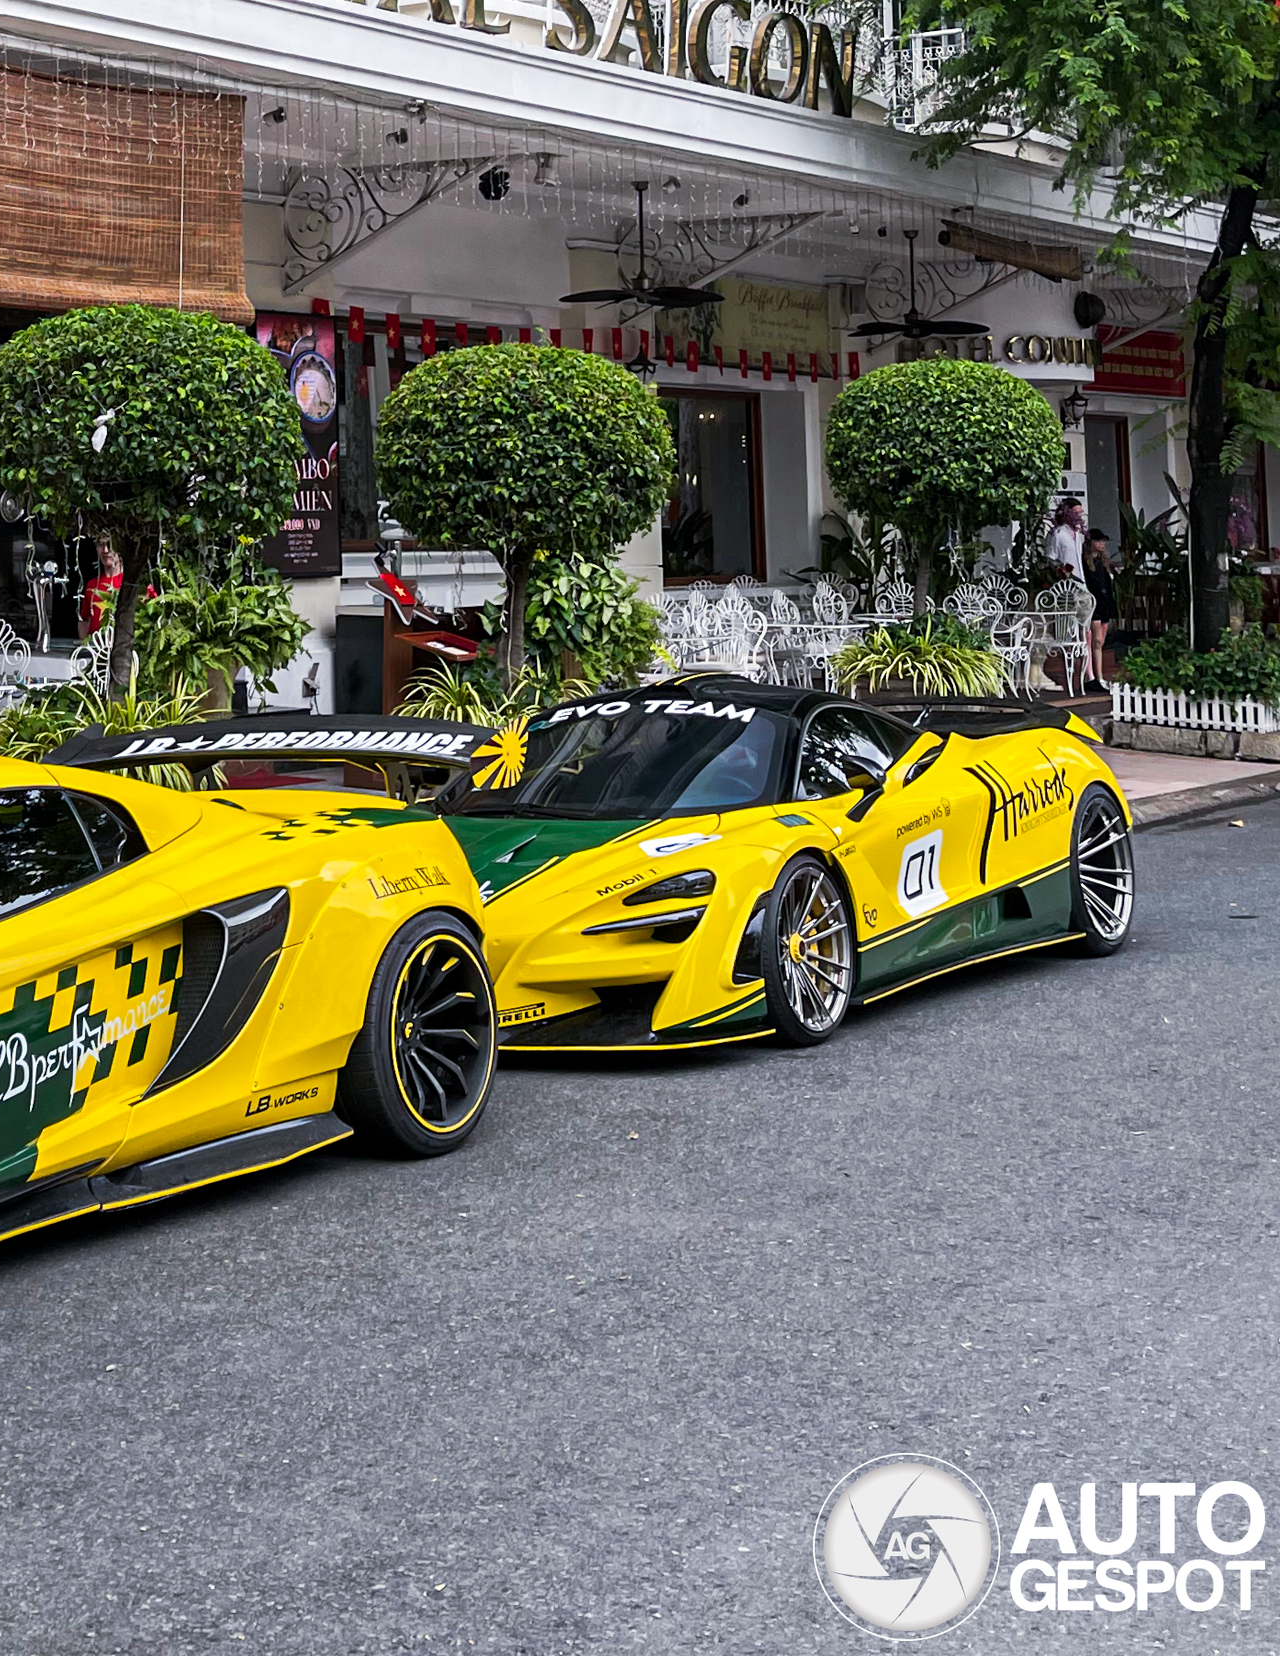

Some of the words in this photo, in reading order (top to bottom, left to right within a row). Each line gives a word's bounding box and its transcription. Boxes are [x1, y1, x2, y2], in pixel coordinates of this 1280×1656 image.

[543, 0, 858, 118] SAIGON
[549, 701, 631, 723] EVO
[644, 700, 756, 723] TEAM
[215, 731, 474, 756] PERFORMANCE
[962, 747, 1074, 886] Harrods
[366, 875, 421, 900] Liberty
[414, 865, 451, 886] Walk
[596, 874, 645, 897] Mobil
[904, 844, 936, 900] 01
